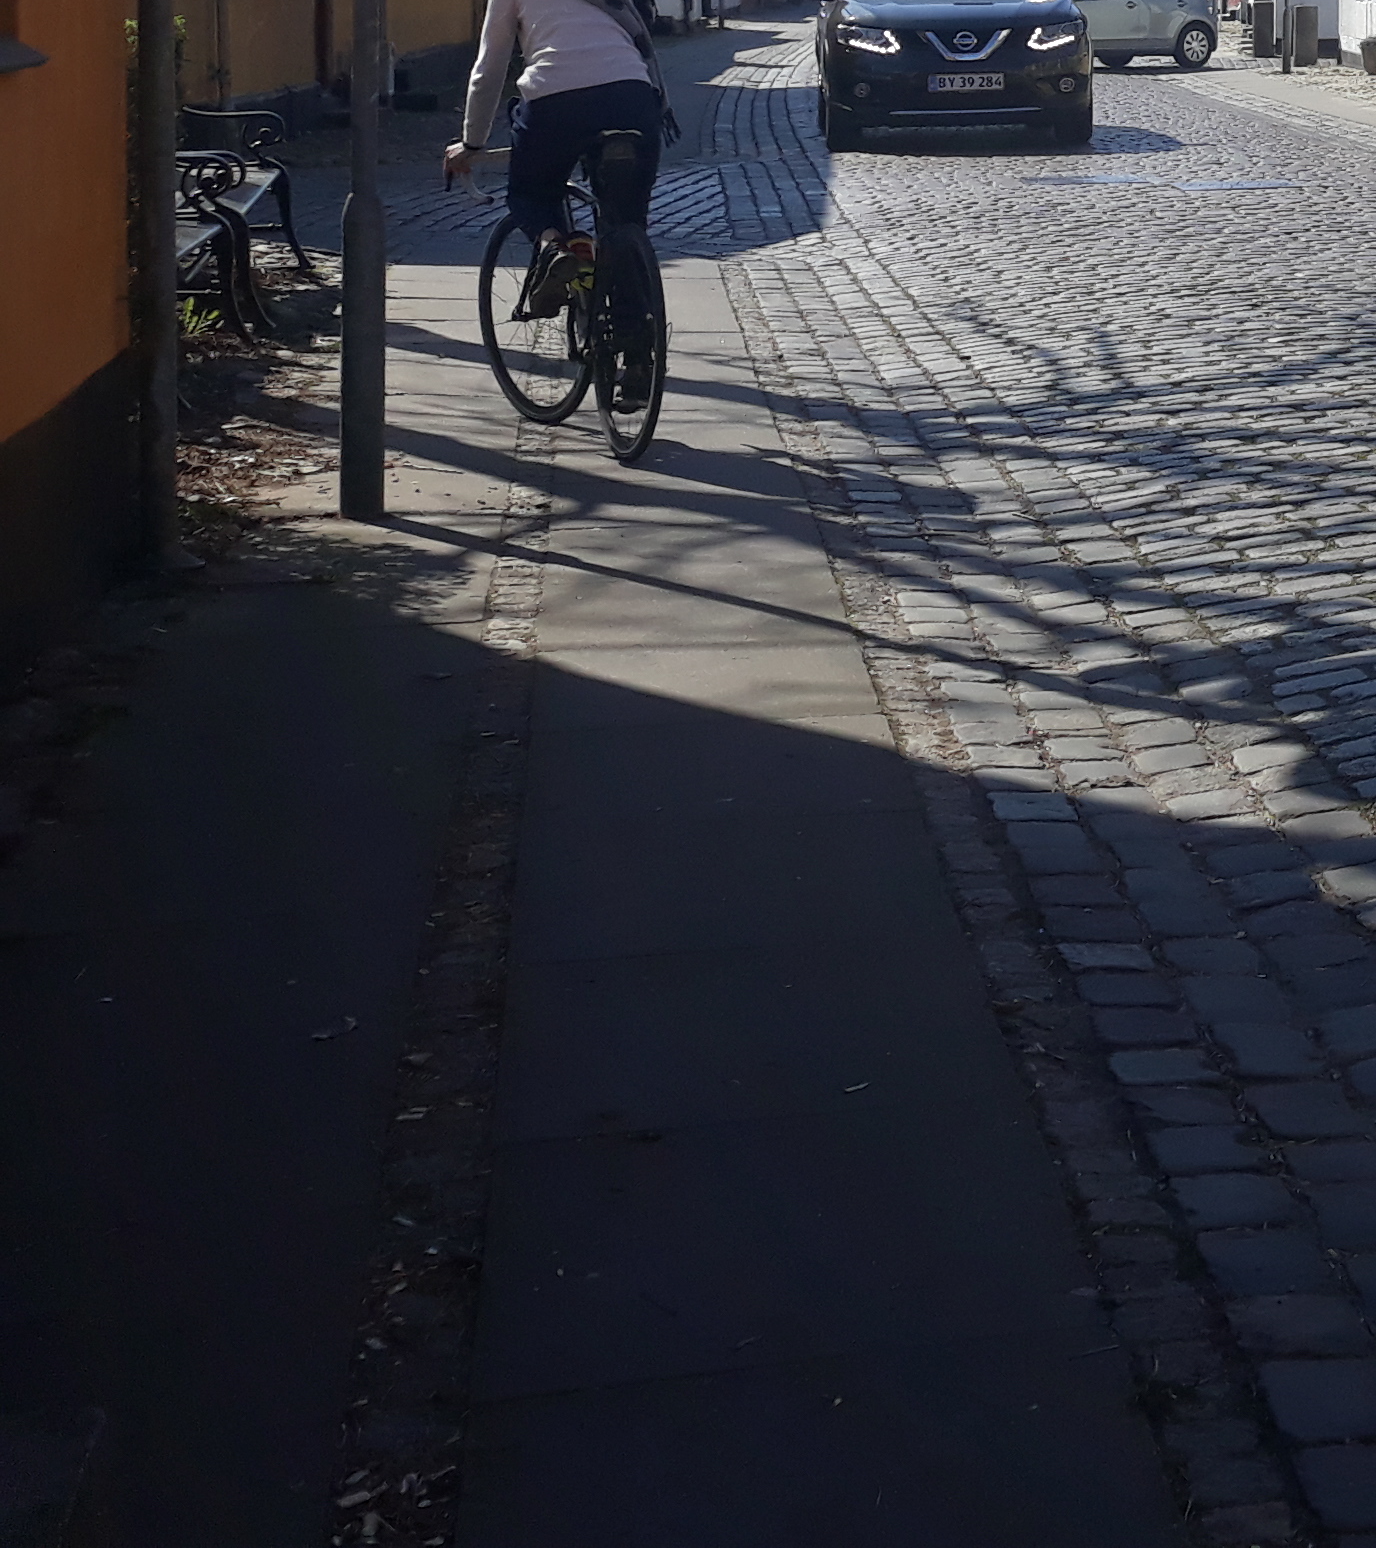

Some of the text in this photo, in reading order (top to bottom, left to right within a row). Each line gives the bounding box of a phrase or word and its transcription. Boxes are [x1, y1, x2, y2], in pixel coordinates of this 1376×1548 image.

[938, 75, 1002, 88] BY 39 284
